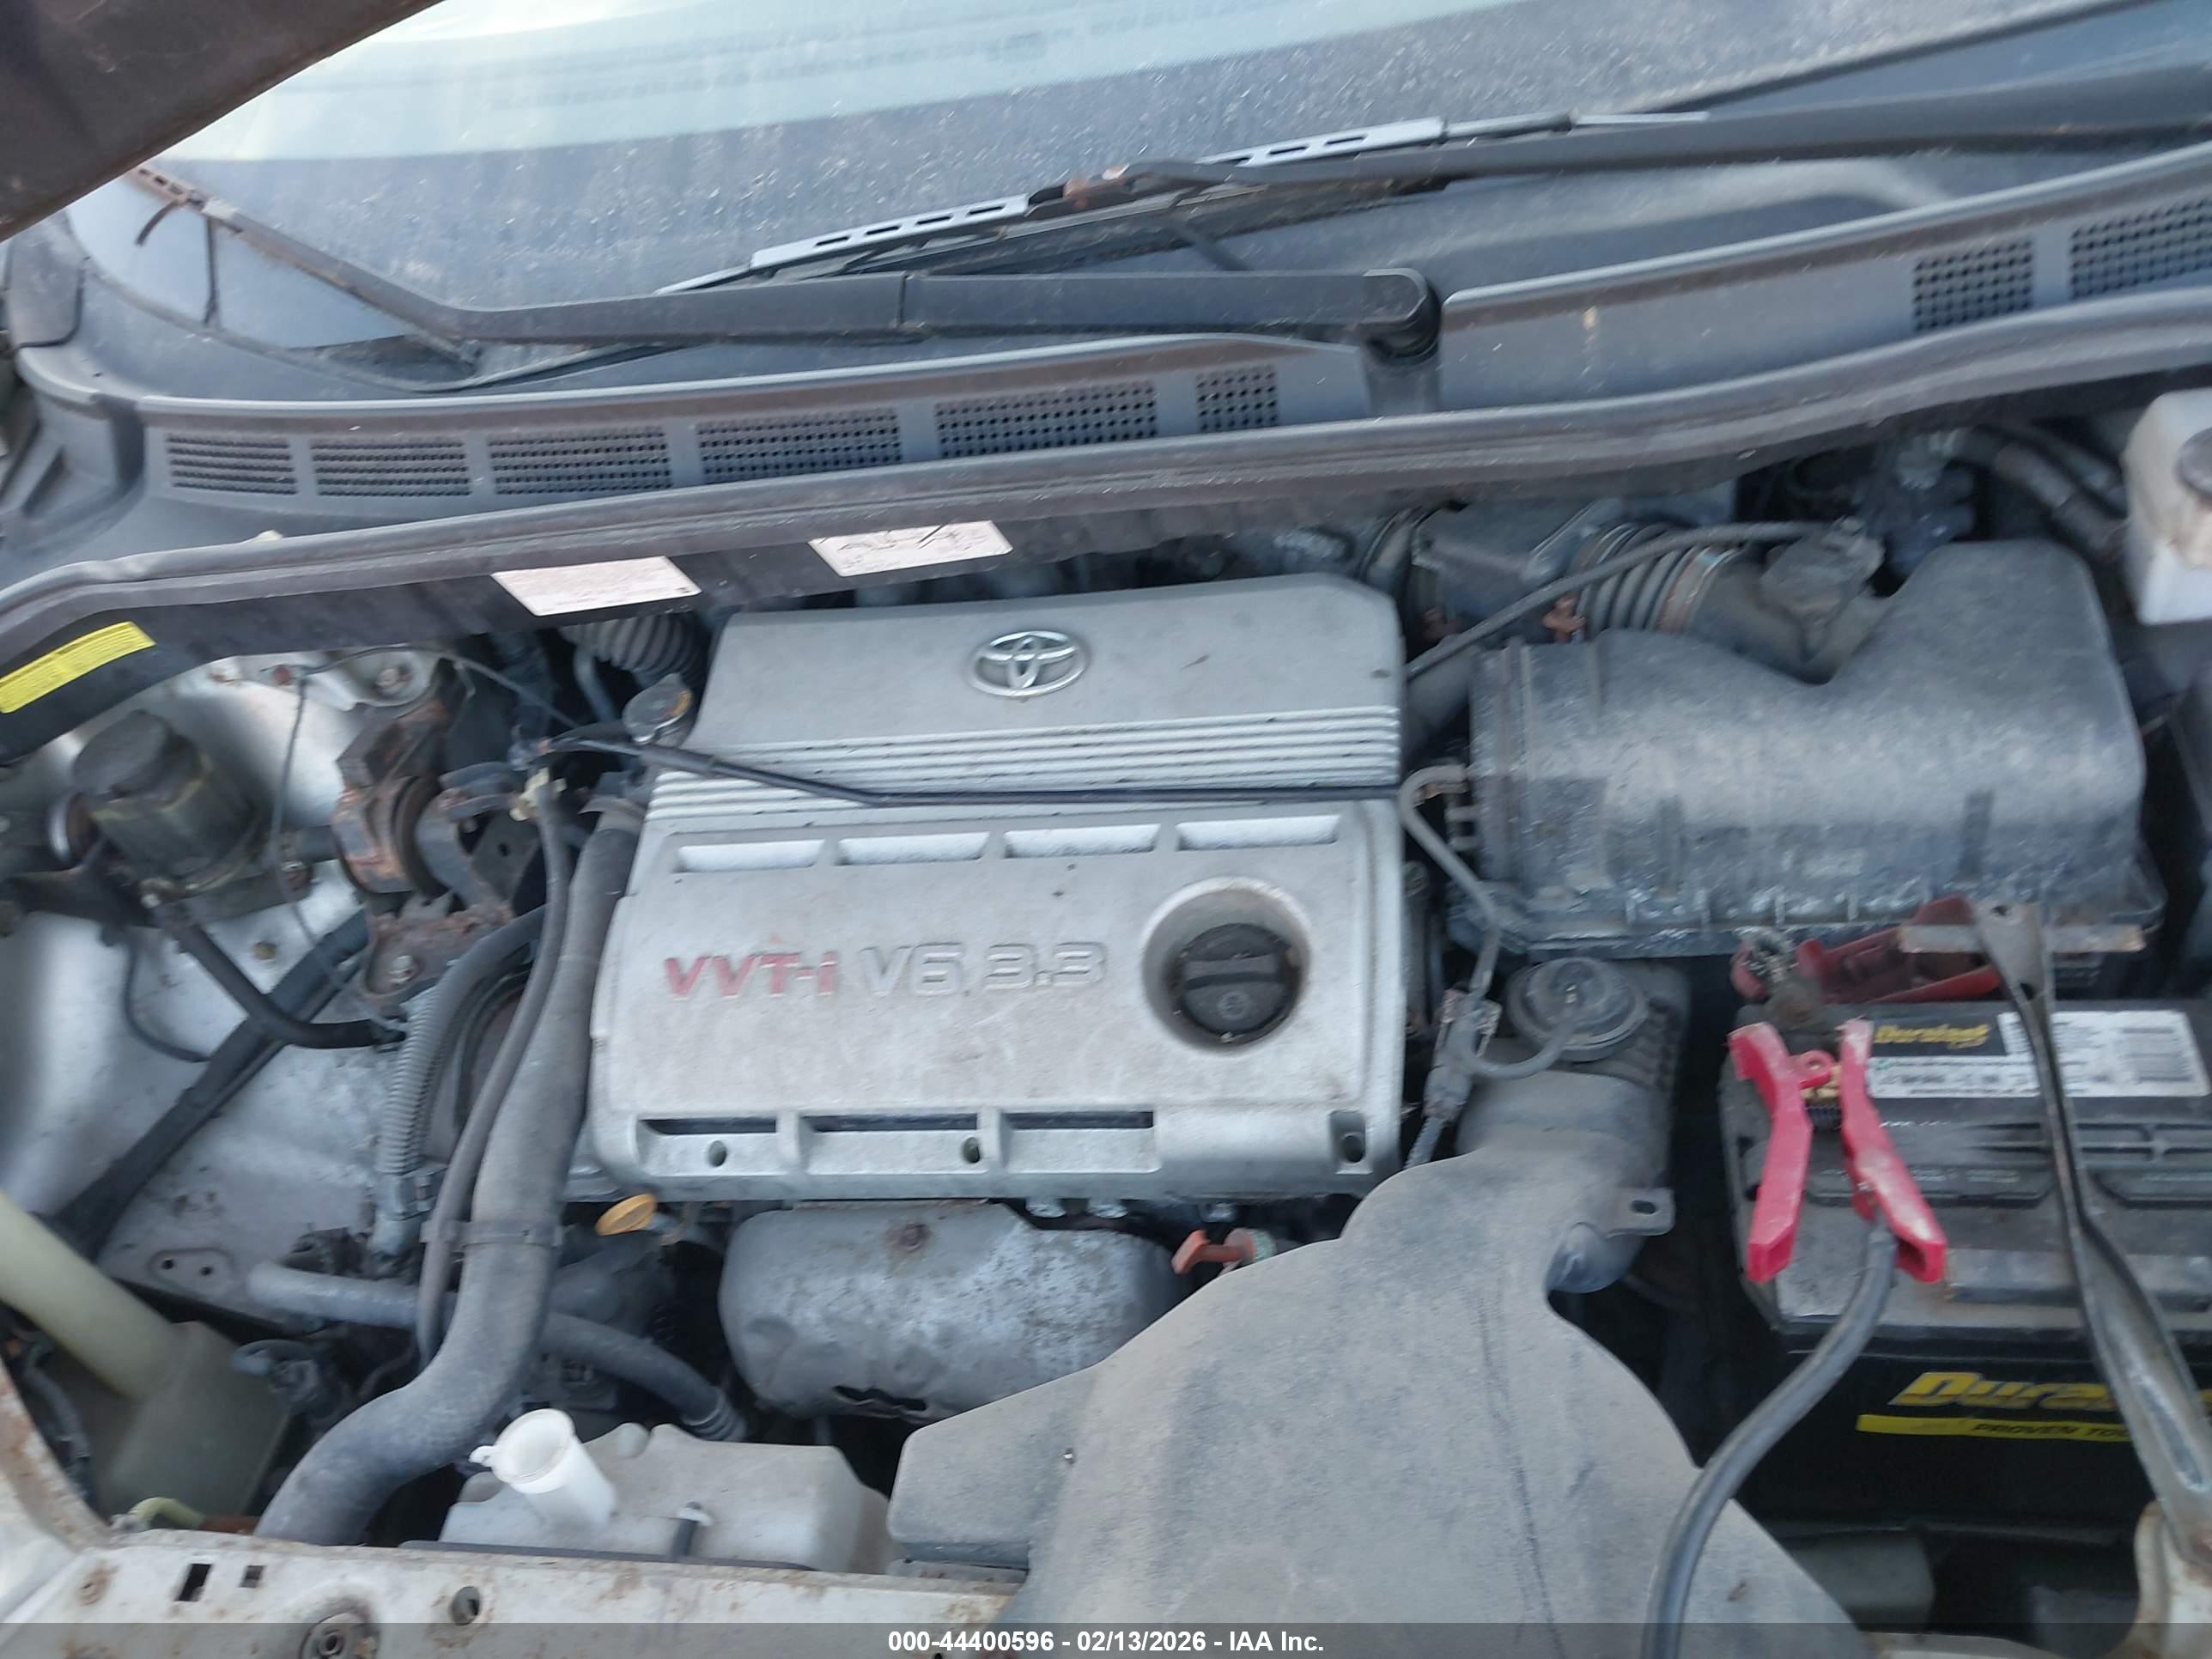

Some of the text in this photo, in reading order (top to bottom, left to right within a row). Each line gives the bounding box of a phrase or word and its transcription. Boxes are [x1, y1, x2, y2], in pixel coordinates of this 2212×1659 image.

[665, 942, 1107, 1000] VVT-i V6 3.3
[1888, 1371, 2118, 1412] Dura
